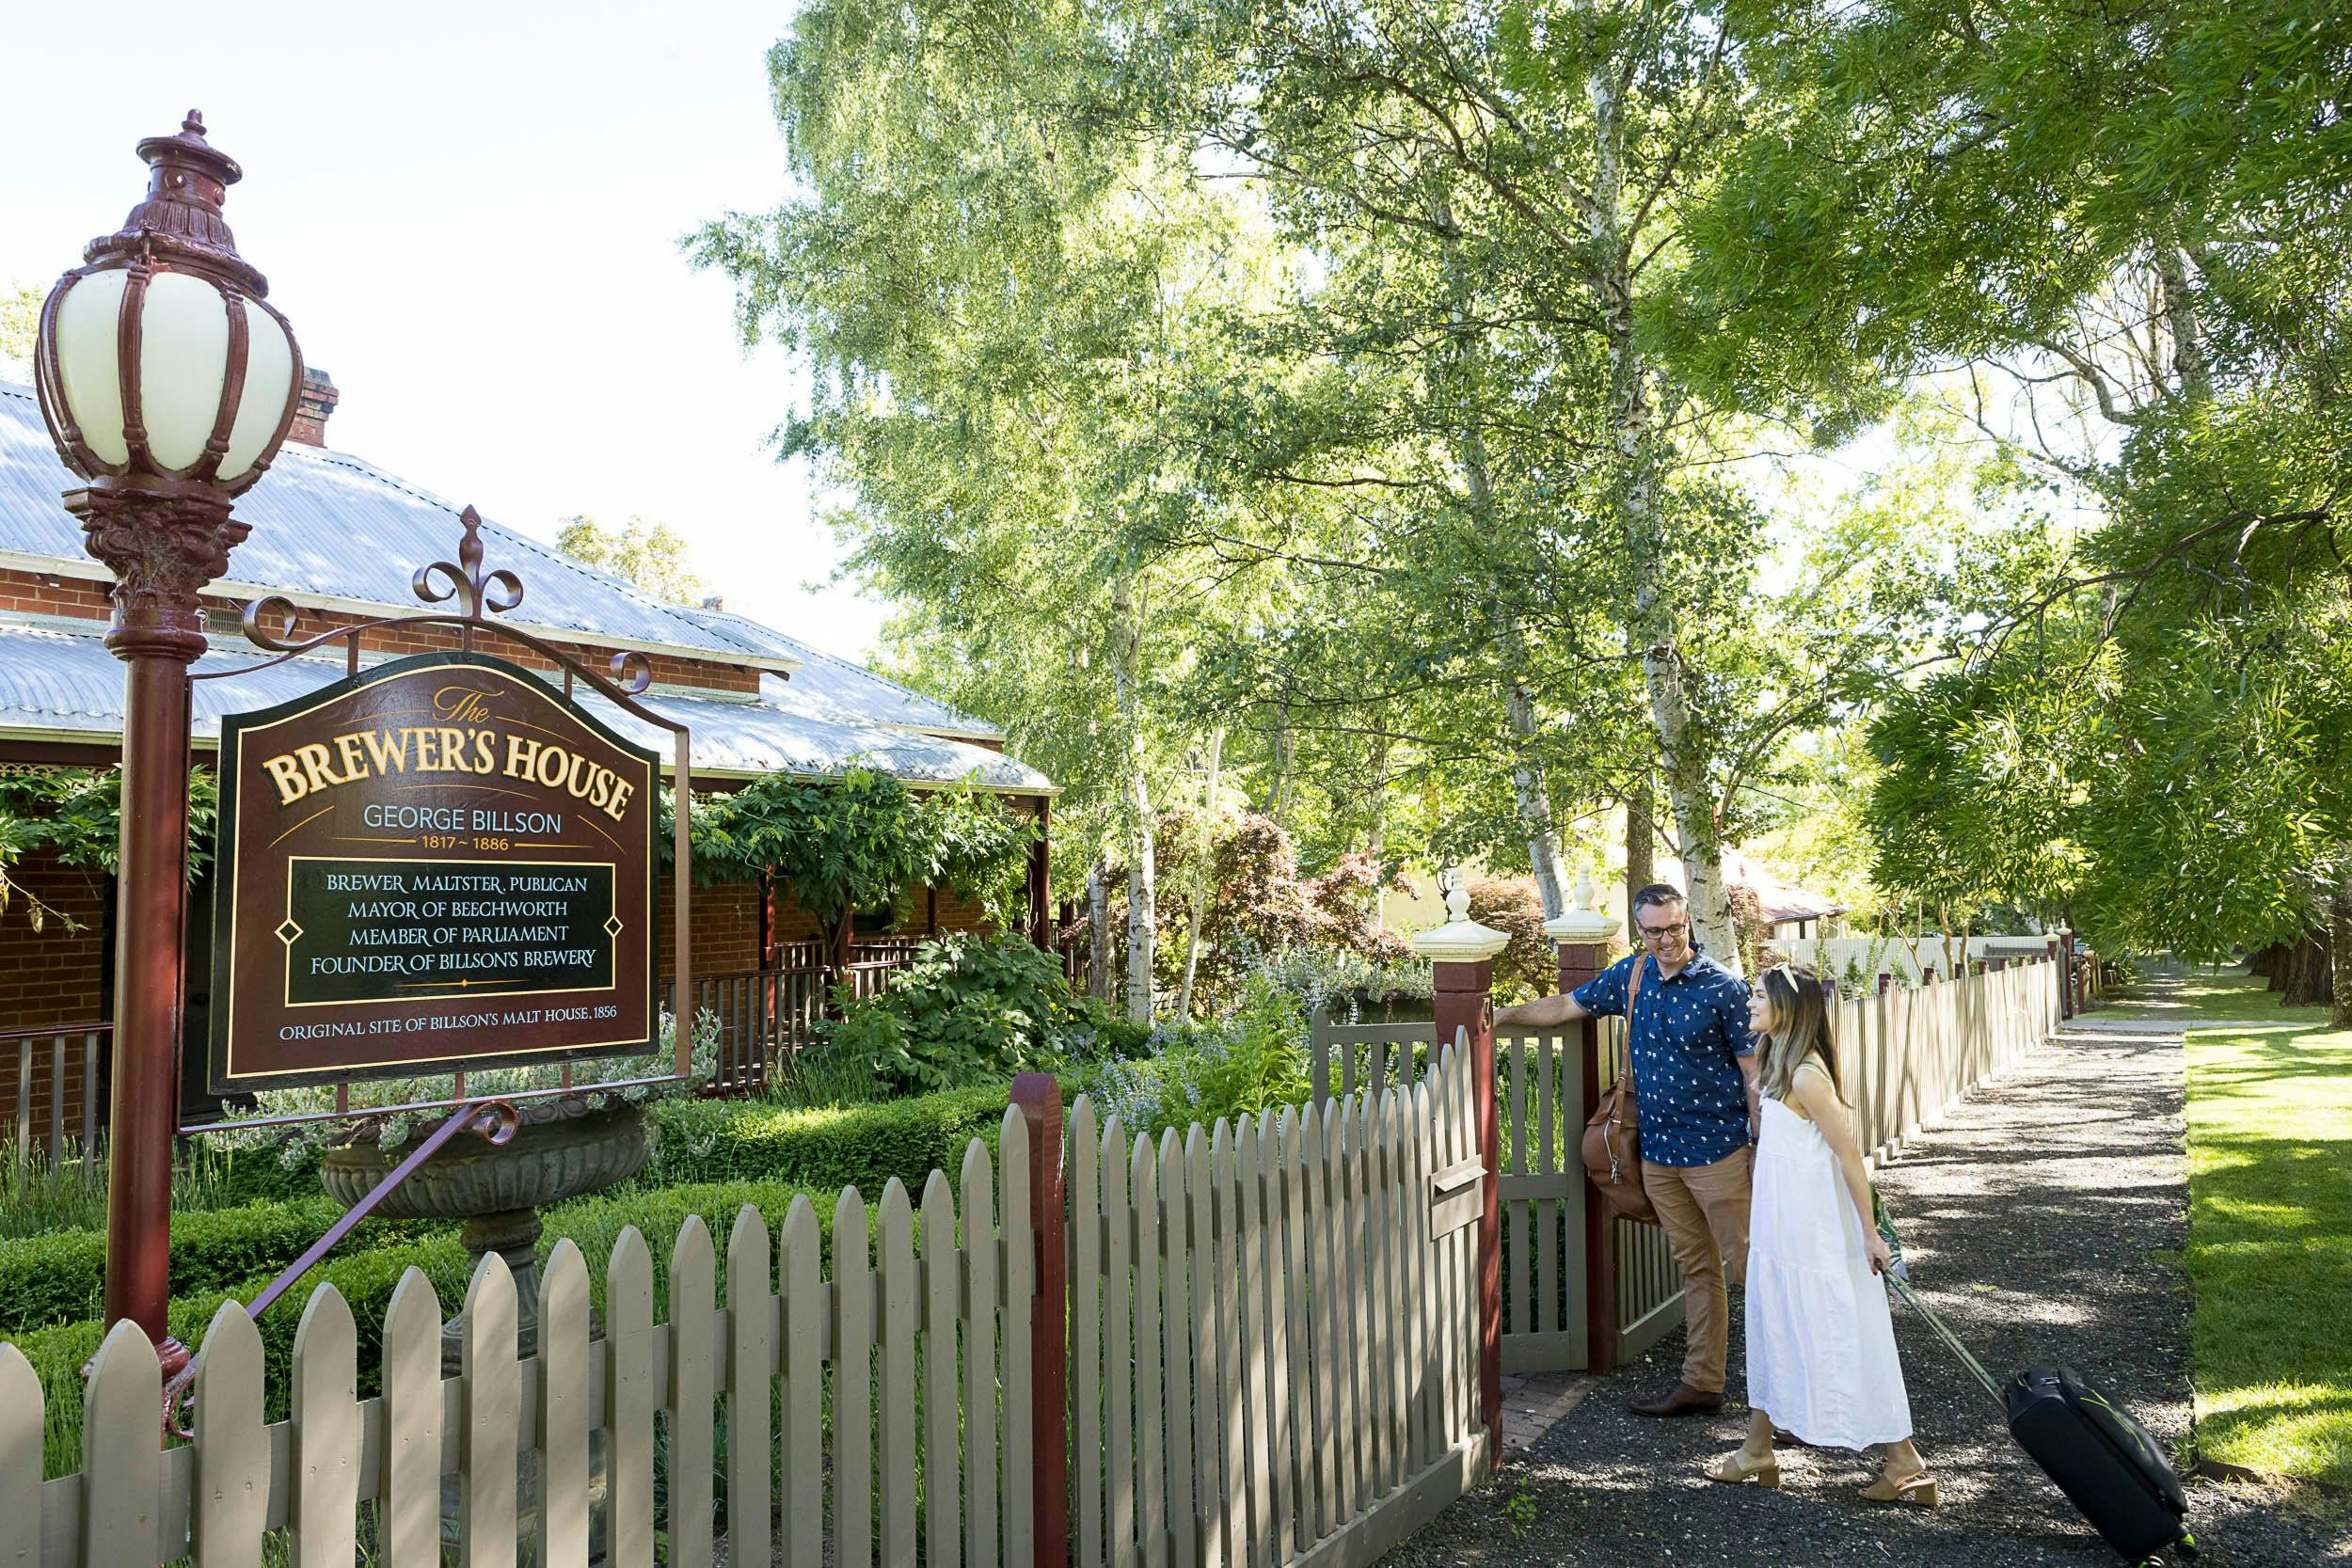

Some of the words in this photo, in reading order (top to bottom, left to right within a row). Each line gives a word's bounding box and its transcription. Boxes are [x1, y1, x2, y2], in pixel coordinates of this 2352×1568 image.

[433, 686, 505, 723] The
[262, 727, 496, 806] BREWER'S
[502, 735, 635, 822] HOUSE
[364, 804, 465, 831] GEORGE
[472, 809, 562, 833] BILLSON
[326, 874, 409, 894] BREWER
[509, 877, 588, 893] PUBLICAN
[347, 901, 421, 920] MAYOR
[422, 901, 447, 918] OF
[451, 900, 568, 918] BEECHWORTH
[348, 927, 433, 947] MEMBER
[433, 927, 458, 944] OF
[462, 925, 570, 944] PARLIAMENT
[310, 955, 411, 975] FOUNDER
[410, 953, 436, 972] OF
[439, 951, 518, 970] BILLSON'S
[523, 949, 597, 968] BREWERY
[279, 1022, 366, 1041] ORIGINAL
[369, 1018, 402, 1035] SITE
[405, 1017, 427, 1032] OF
[430, 1012, 499, 1031] BILLSON'S
[502, 1009, 542, 1026] MALT
[594, 1005, 617, 1019] 1856
